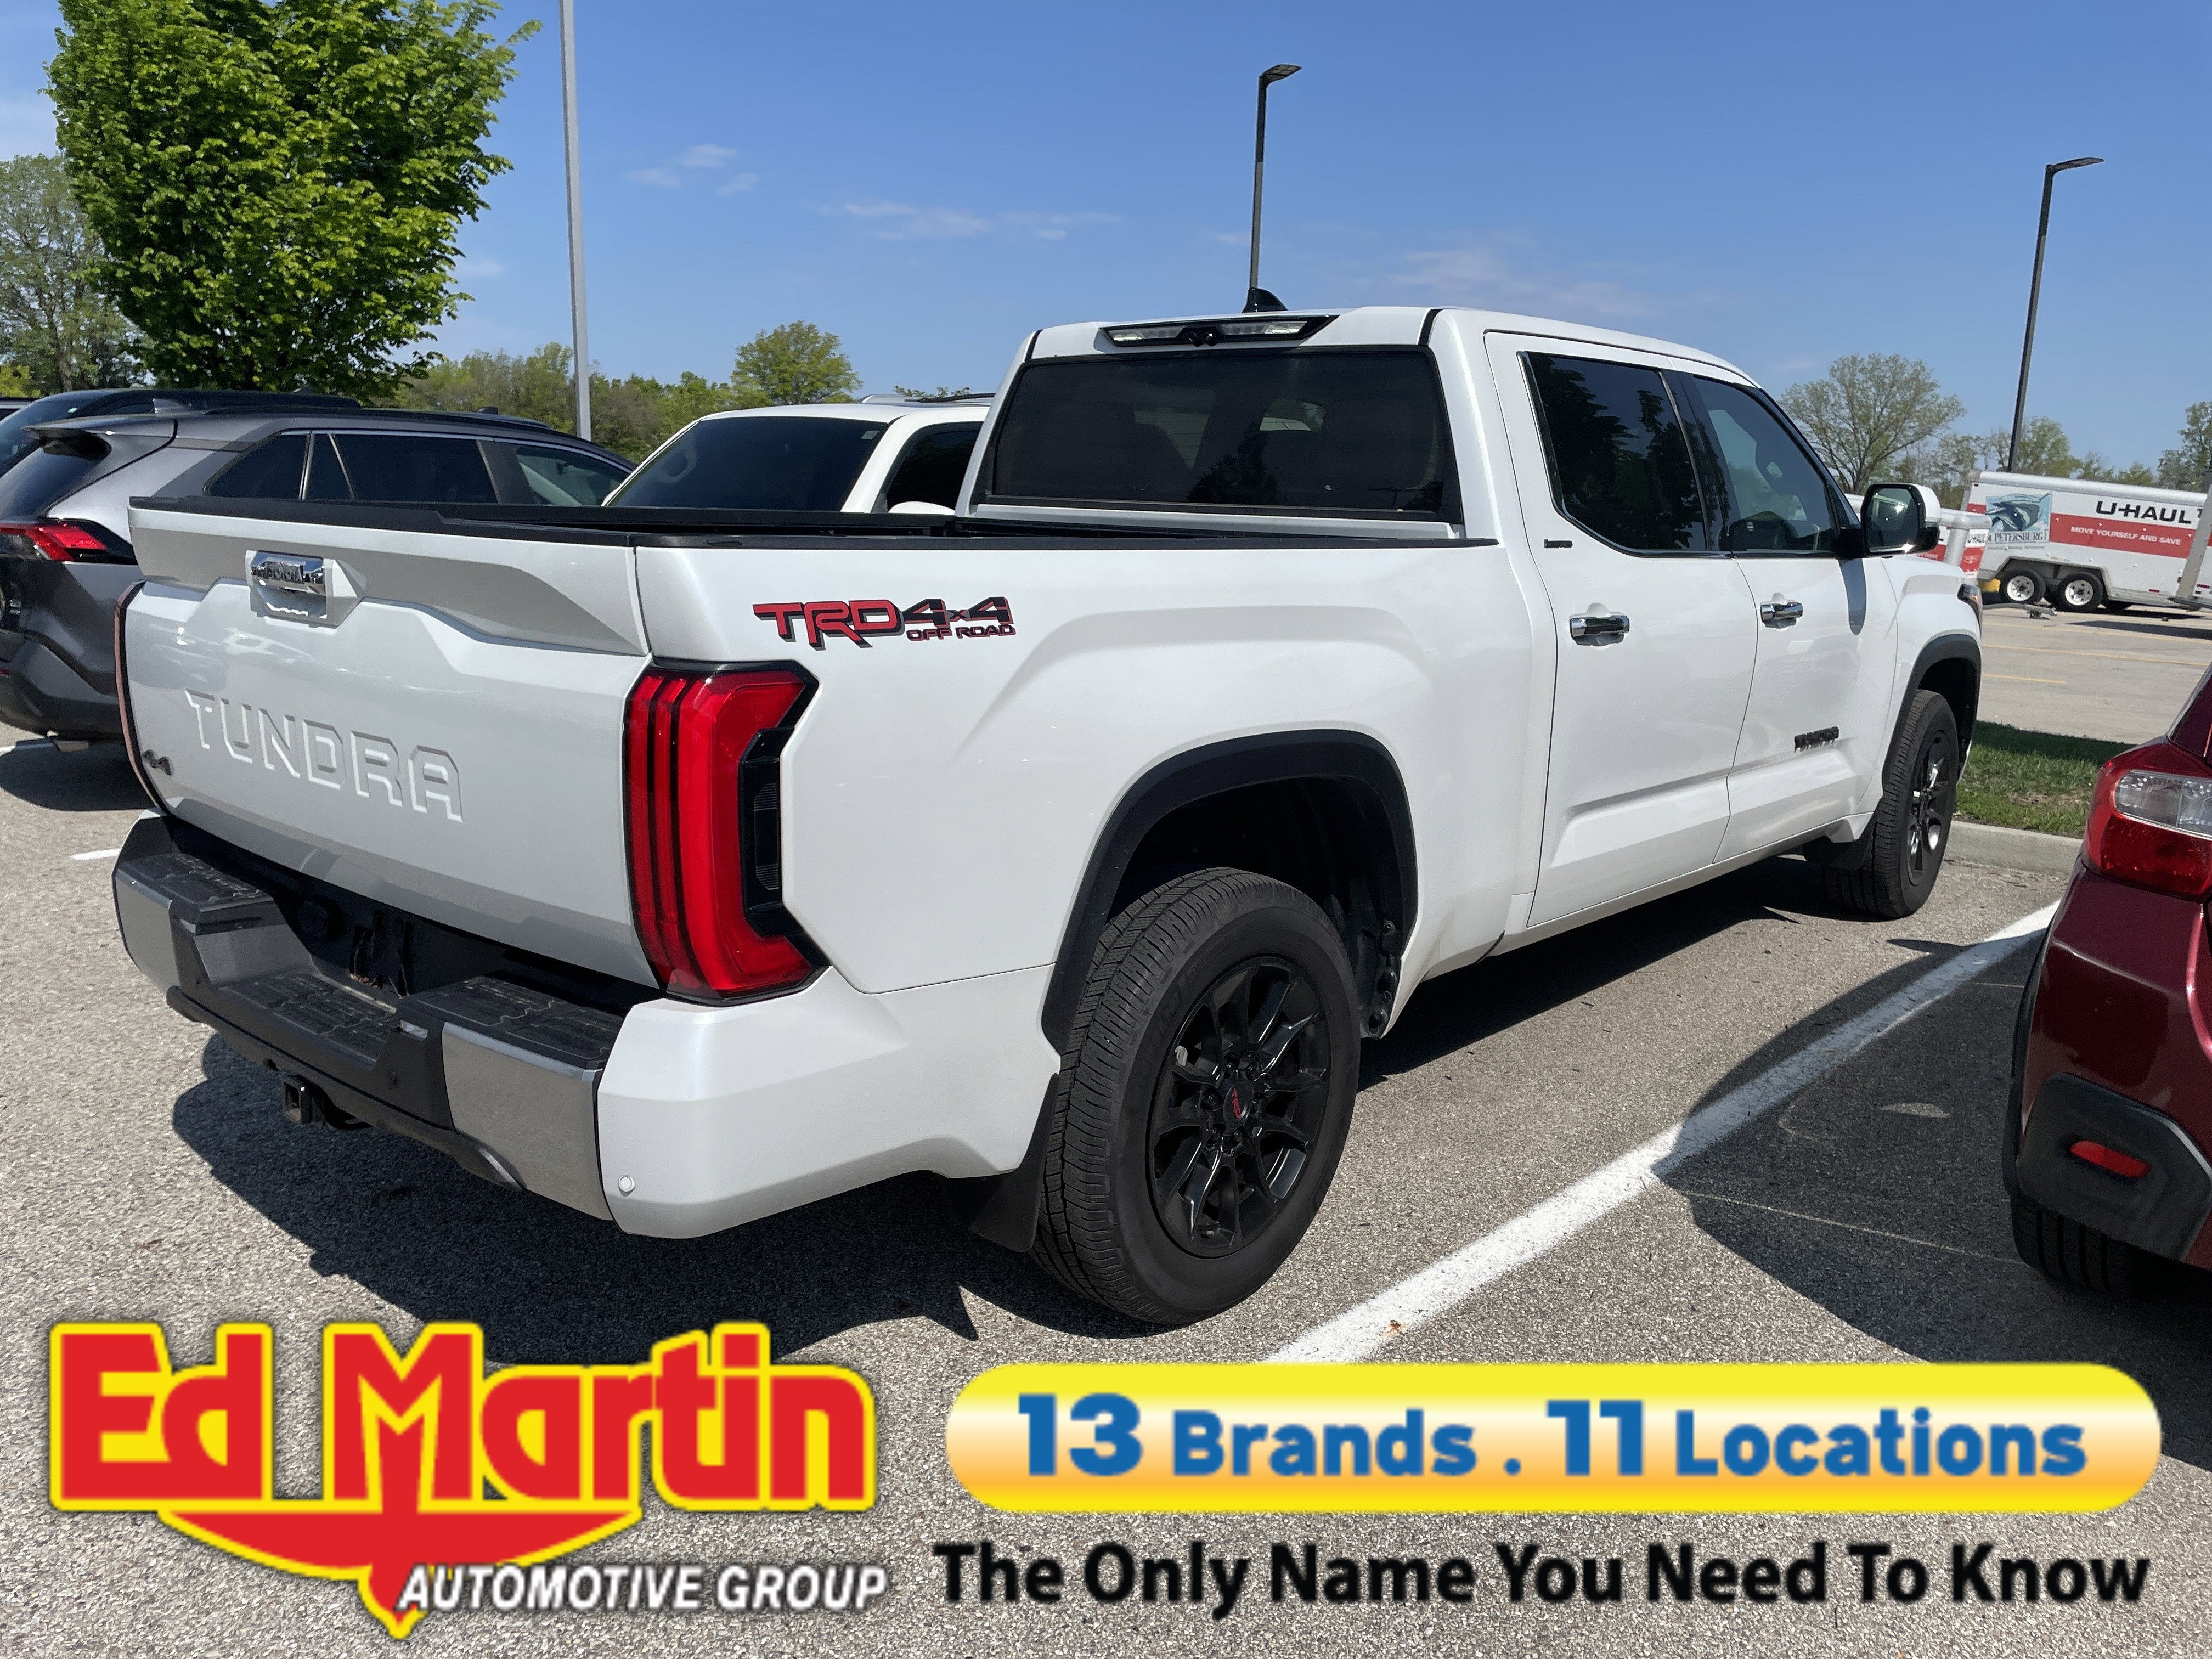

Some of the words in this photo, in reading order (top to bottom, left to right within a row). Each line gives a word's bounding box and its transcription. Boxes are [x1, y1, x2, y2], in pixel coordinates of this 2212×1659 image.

[2096, 500, 2192, 524] U-HAUL
[2070, 526, 2095, 535] MOVE
[2096, 529, 2138, 540] YOURSELF
[2159, 537, 2182, 546] SAVE
[753, 599, 904, 651] TRD
[907, 628, 952, 641] OFF
[955, 624, 1017, 639] ROAD
[184, 689, 462, 822] TUNDRA
